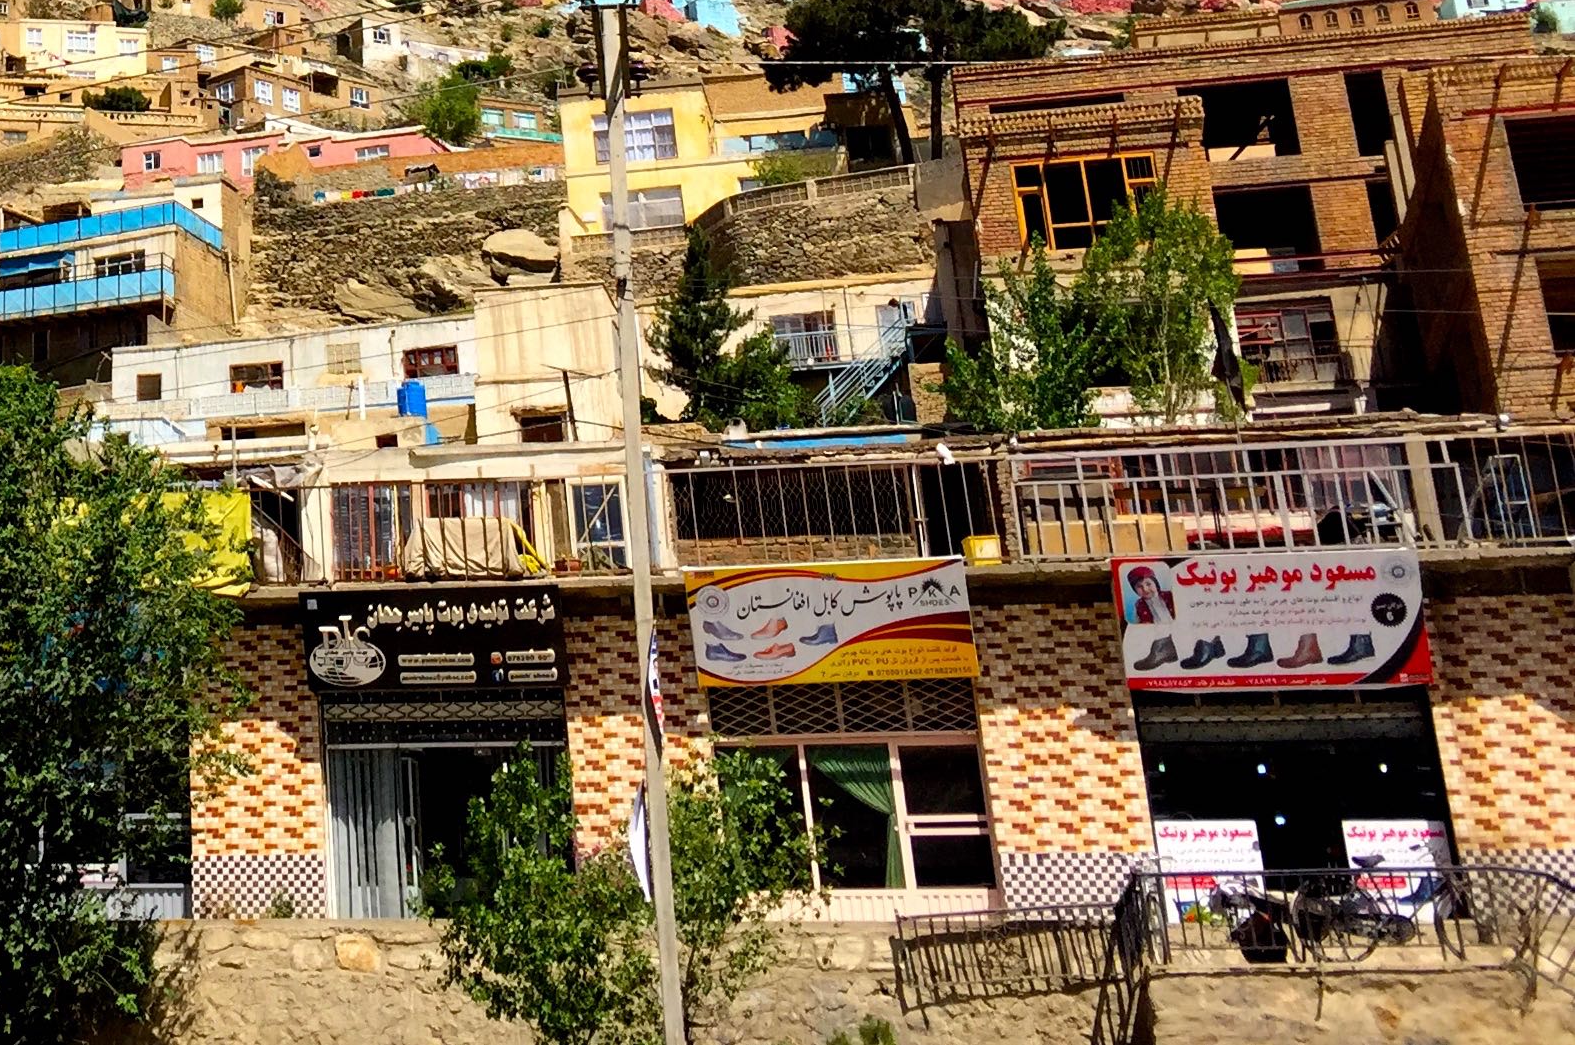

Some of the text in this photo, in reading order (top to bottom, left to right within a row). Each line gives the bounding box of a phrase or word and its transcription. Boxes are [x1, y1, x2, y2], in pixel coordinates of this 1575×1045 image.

[1176, 561, 1238, 593] بوتیک
[1310, 561, 1377, 591] مسعود
[736, 587, 810, 620] افغانستان
[813, 588, 842, 617] کابل
[841, 584, 902, 616] پاپوش
[908, 585, 961, 598] P K A
[436, 600, 464, 630] بوت
[514, 594, 556, 624] شرکت
[1158, 826, 1188, 842] بوتیک
[1222, 827, 1253, 842] مسعود
[1412, 827, 1445, 841] مسعود
